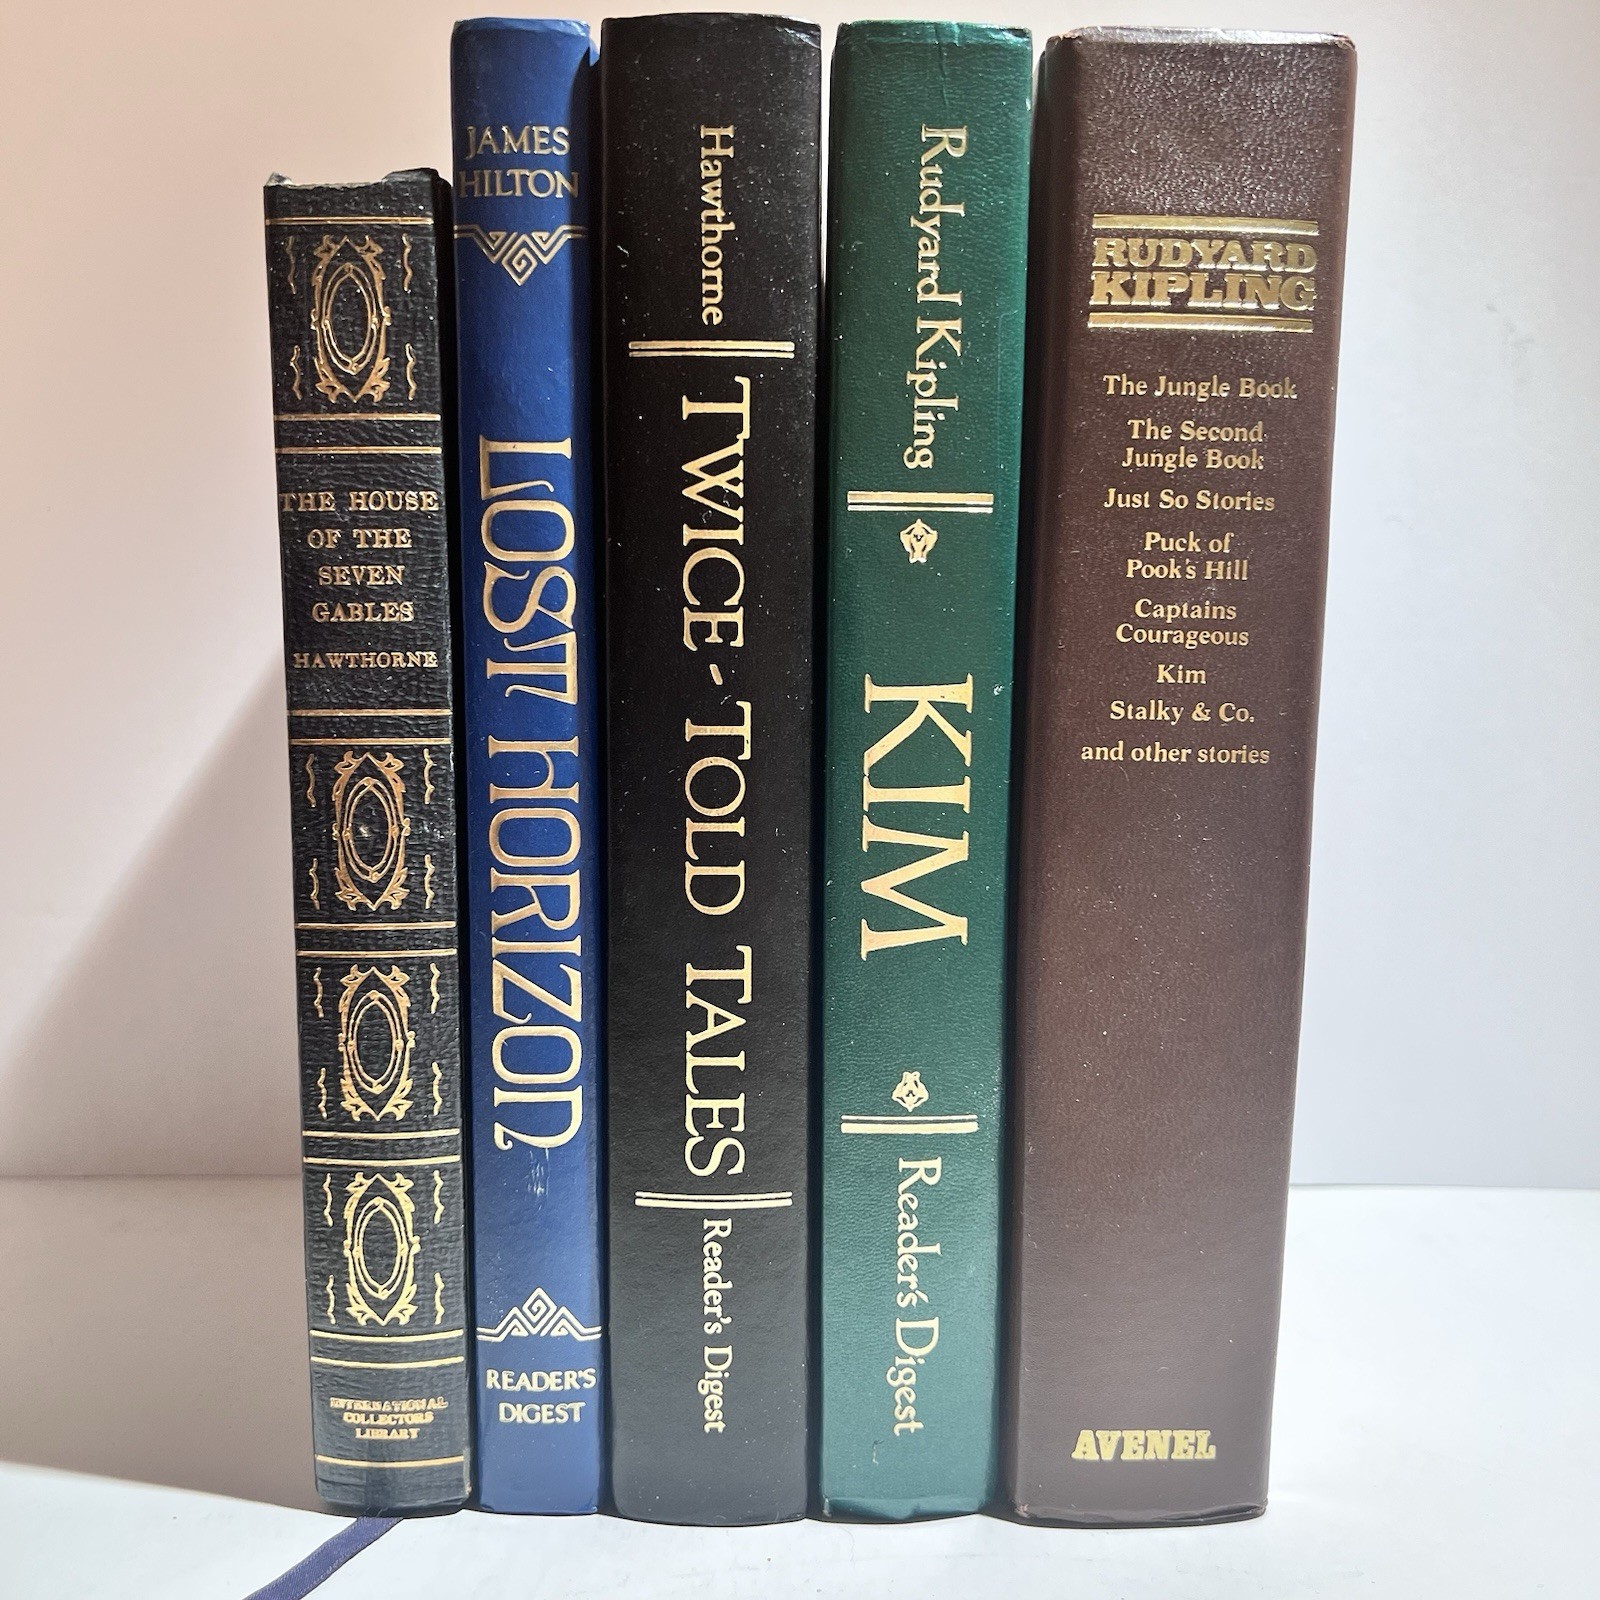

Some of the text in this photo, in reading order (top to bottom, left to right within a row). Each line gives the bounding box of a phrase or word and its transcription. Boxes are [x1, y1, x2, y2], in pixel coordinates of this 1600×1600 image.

[466, 126, 570, 160] JAMES
[459, 169, 579, 198] HILTON
[700, 124, 736, 325] Hawthorne
[1092, 237, 1317, 273] RUDYARD
[903, 123, 967, 470] Rudyard Kipling
[1089, 271, 1316, 311] KIPLING
[1103, 374, 1297, 402] The Jungle Book
[1127, 418, 1264, 443] The Second
[1122, 446, 1264, 473] Jungle Book
[278, 490, 440, 512] THE HOUSE
[1103, 488, 1276, 511] Just So Stories
[307, 528, 413, 549] OF THE
[1144, 531, 1235, 554] Puck of
[318, 565, 406, 586] SEVEN
[1126, 558, 1249, 581] Pook's Hill
[312, 601, 415, 623] GABLES
[1134, 598, 1237, 623] Captains
[1116, 623, 1250, 650] Courageous
[293, 651, 439, 669] HAWTHORNE
[1156, 664, 1207, 685] Kim
[1110, 700, 1255, 726] Stalky & Co.
[1081, 741, 1270, 765] and other stories
[479, 435, 584, 1152] LOST HORIZON
[860, 672, 974, 961] KIM
[684, 945, 752, 1177] TALES
[886, 1156, 943, 1437] Reader's Digest
[697, 1217, 734, 1434] Reader's Digest
[486, 1367, 598, 1392] READER'S
[329, 1396, 449, 1412] INTERNATIONAL
[498, 1401, 587, 1425] DIGEST
[342, 1411, 435, 1426] COLLECTORS
[355, 1427, 421, 1440] LIBRARY
[1071, 1429, 1217, 1461] AVENEL
